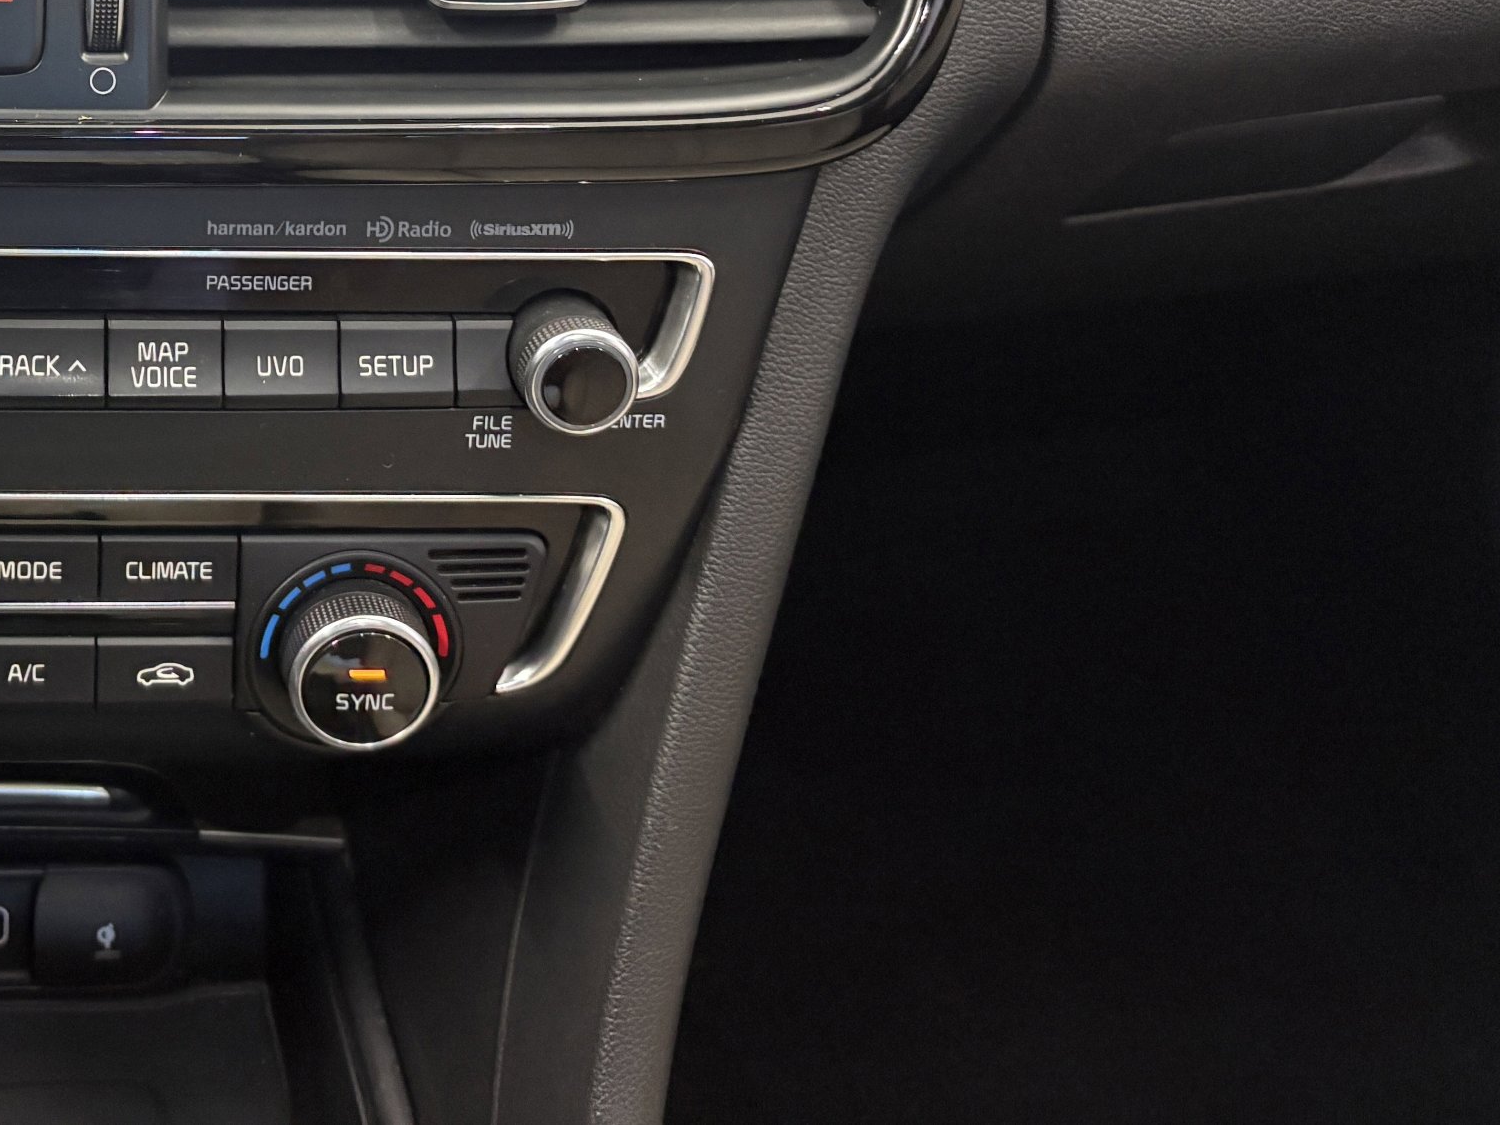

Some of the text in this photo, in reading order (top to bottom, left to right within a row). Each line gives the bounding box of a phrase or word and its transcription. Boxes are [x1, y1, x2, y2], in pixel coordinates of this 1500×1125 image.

[207, 220, 346, 236] harman/kardon
[398, 221, 451, 238] Radio
[206, 276, 312, 291] PASSENGER
[137, 342, 189, 362] MAP
[257, 355, 304, 377] UVO
[359, 356, 434, 377] SETUP
[130, 366, 197, 388] VOICE
[472, 415, 513, 431] FILE
[611, 414, 666, 429] NTER
[465, 434, 512, 449] TUNE
[125, 562, 213, 581] CLIMATE
[7, 664, 46, 684] A/C
[335, 693, 394, 712] SYNC
